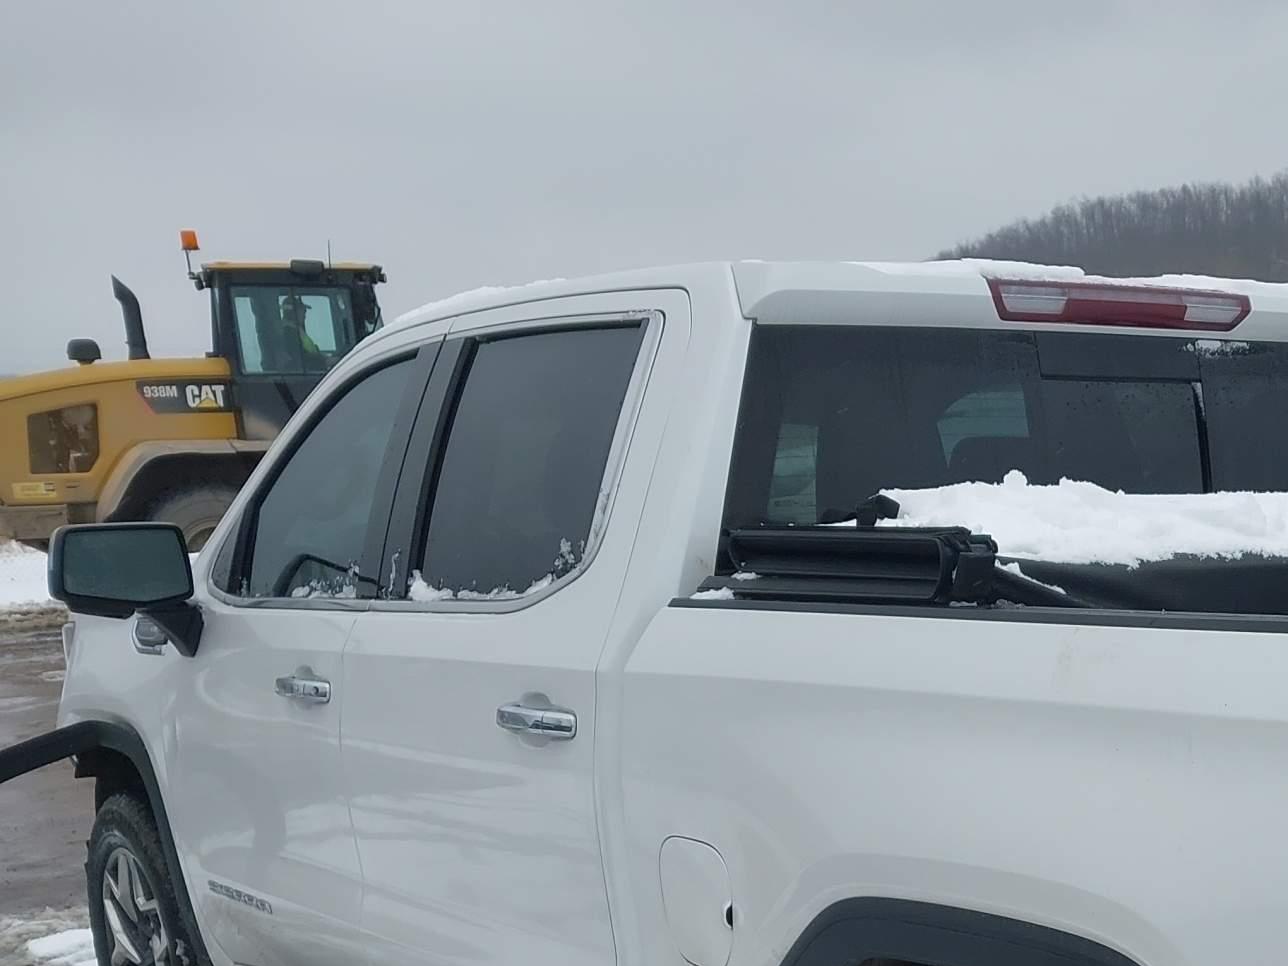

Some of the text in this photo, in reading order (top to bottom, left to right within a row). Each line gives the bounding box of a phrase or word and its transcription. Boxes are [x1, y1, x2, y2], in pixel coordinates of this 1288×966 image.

[143, 384, 225, 408] 938M CAT
[207, 879, 273, 915] SIERRA
